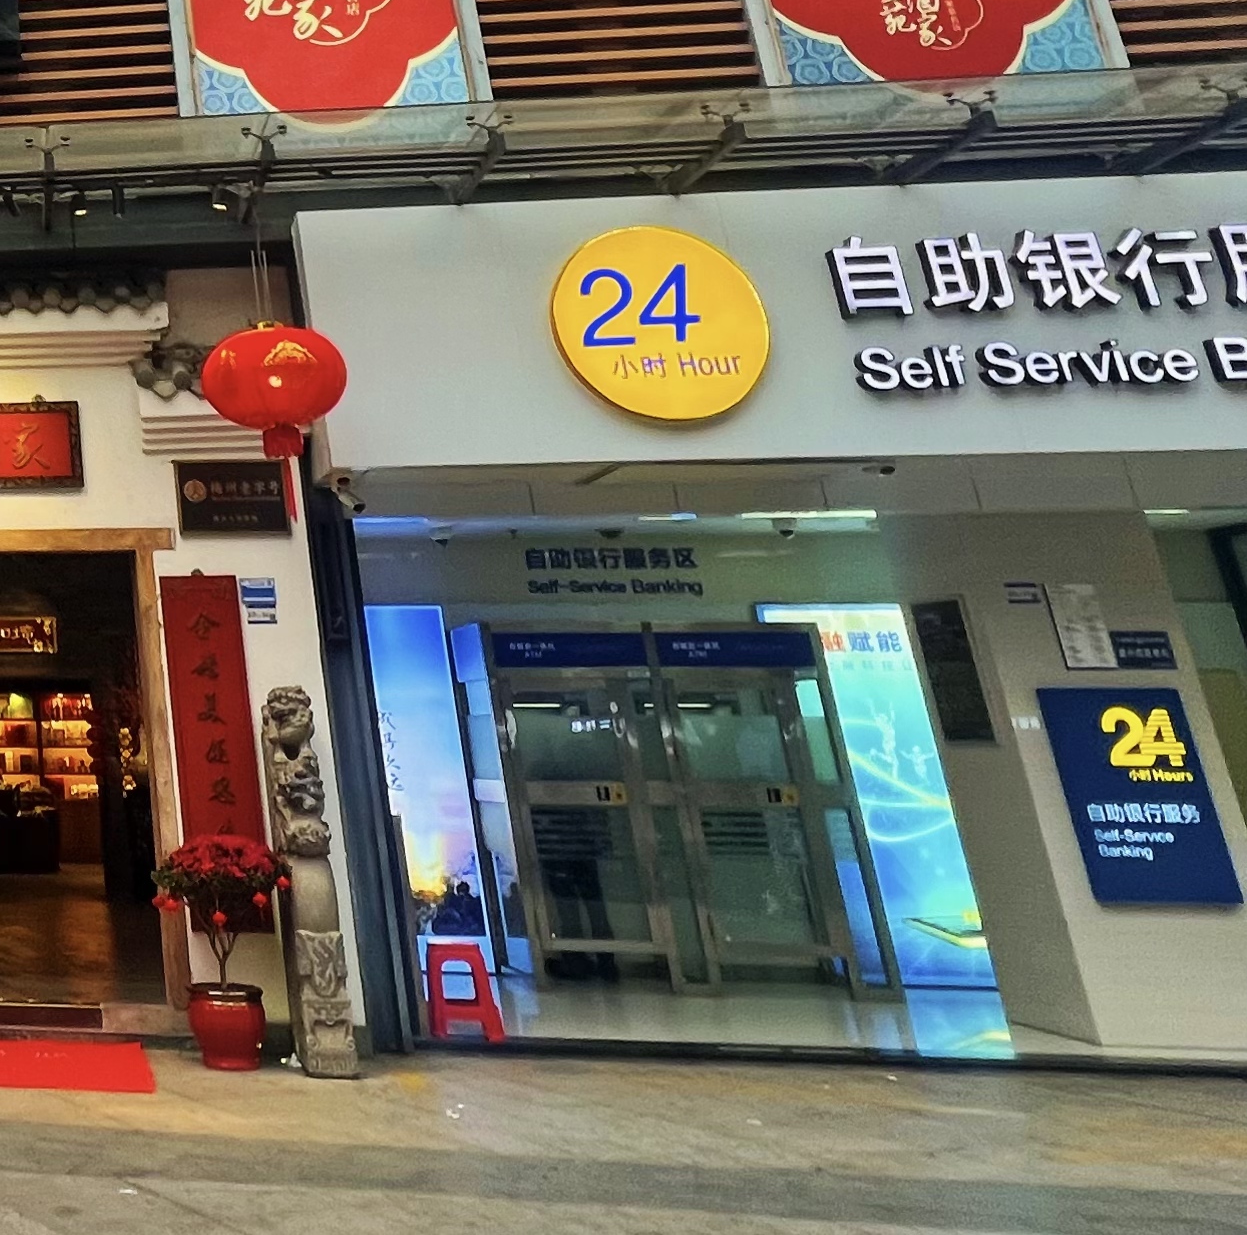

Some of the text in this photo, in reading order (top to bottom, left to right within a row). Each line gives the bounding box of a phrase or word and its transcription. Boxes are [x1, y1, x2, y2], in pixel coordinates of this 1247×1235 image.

[579, 263, 701, 347] 24
[613, 352, 741, 379] 小时 Hour
[856, 343, 967, 391] Self
[978, 338, 1200, 387] Service
[525, 547, 698, 570] 自助银行服务区
[527, 579, 703, 596] Self-Service Banking
[1087, 802, 1201, 824] 自助银行服务
[1094, 829, 1175, 844] Self-Service
[1098, 845, 1154, 861] Banking
